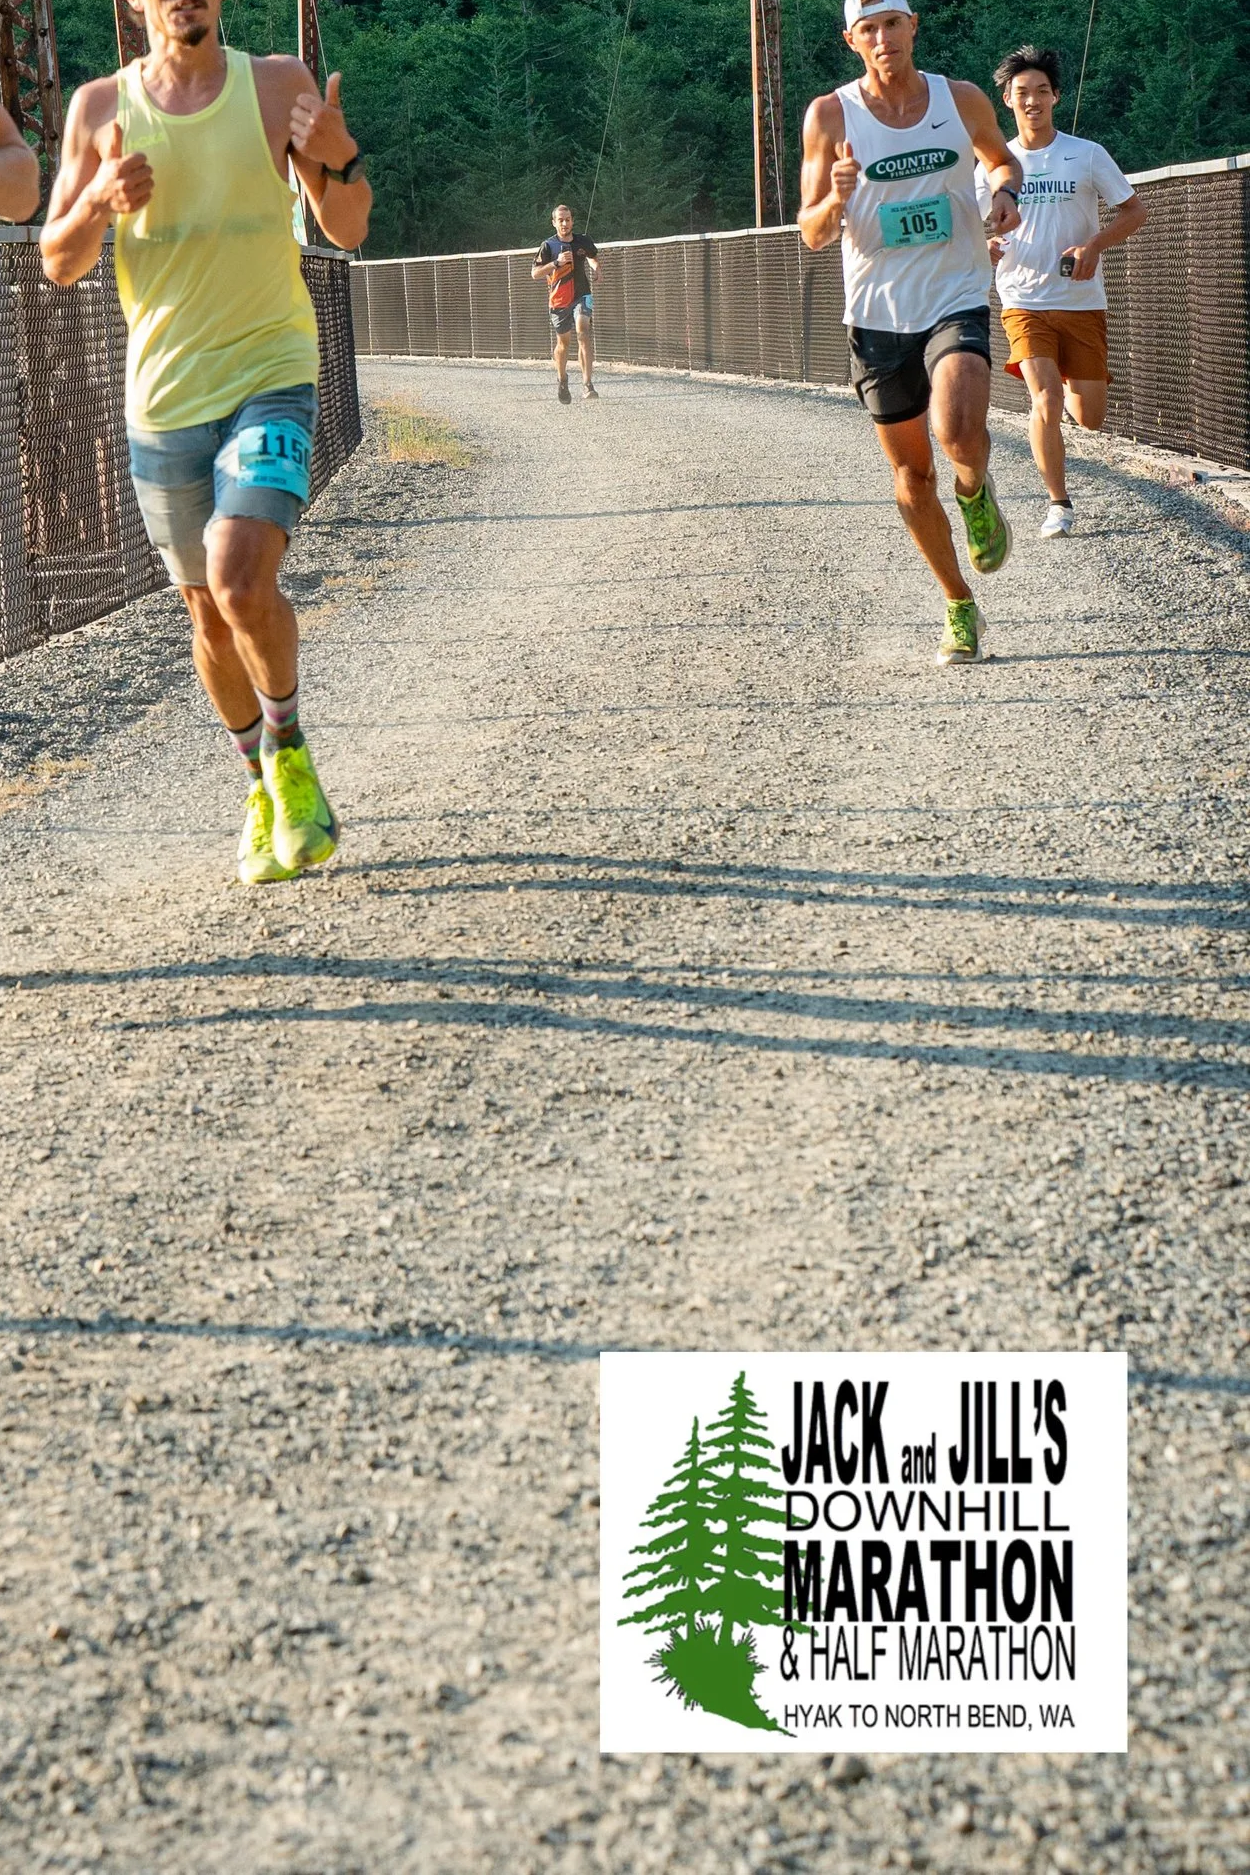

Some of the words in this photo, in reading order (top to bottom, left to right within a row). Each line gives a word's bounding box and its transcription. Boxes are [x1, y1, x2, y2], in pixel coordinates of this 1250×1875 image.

[876, 151, 947, 174] COUNTRY
[890, 164, 935, 178] FINANCIAL
[1020, 181, 1076, 195] ODINVILLE
[899, 211, 938, 236] 105
